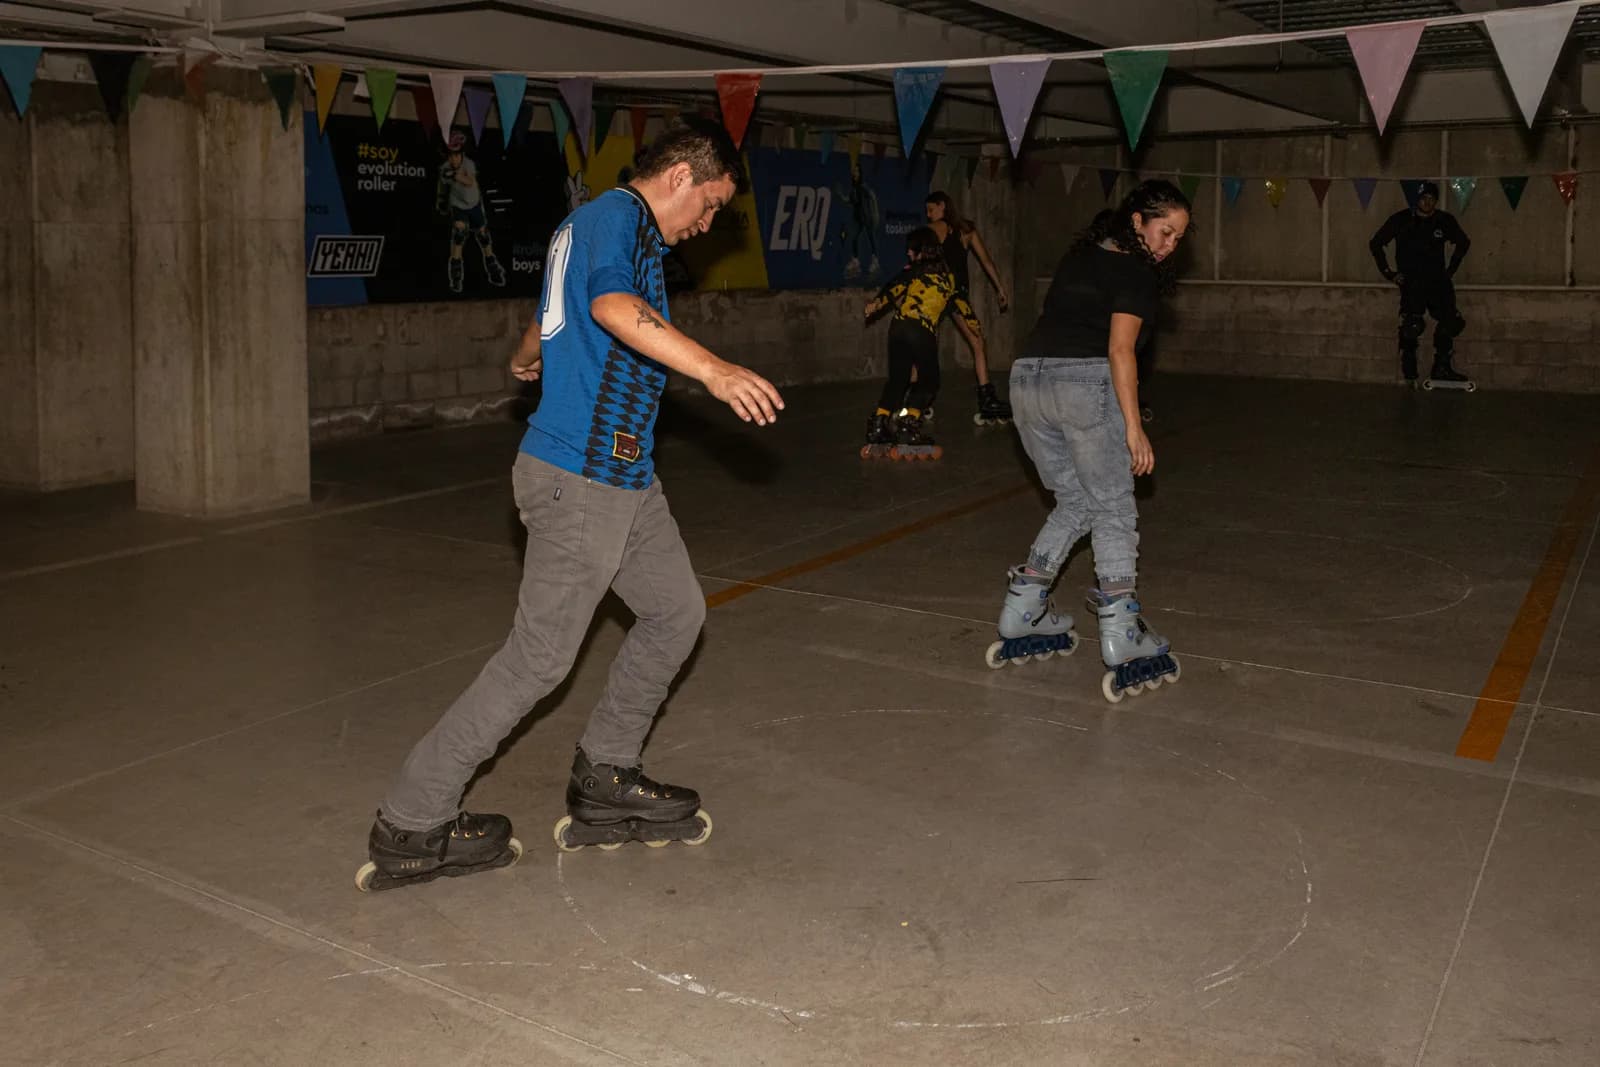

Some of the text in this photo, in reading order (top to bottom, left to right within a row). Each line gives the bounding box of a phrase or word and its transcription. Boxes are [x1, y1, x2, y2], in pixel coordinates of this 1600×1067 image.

[358, 143, 399, 163] #soy
[357, 160, 426, 177] evolution
[357, 175, 397, 191] roller
[316, 241, 378, 271] YEAH!
[512, 257, 542, 274] boys
